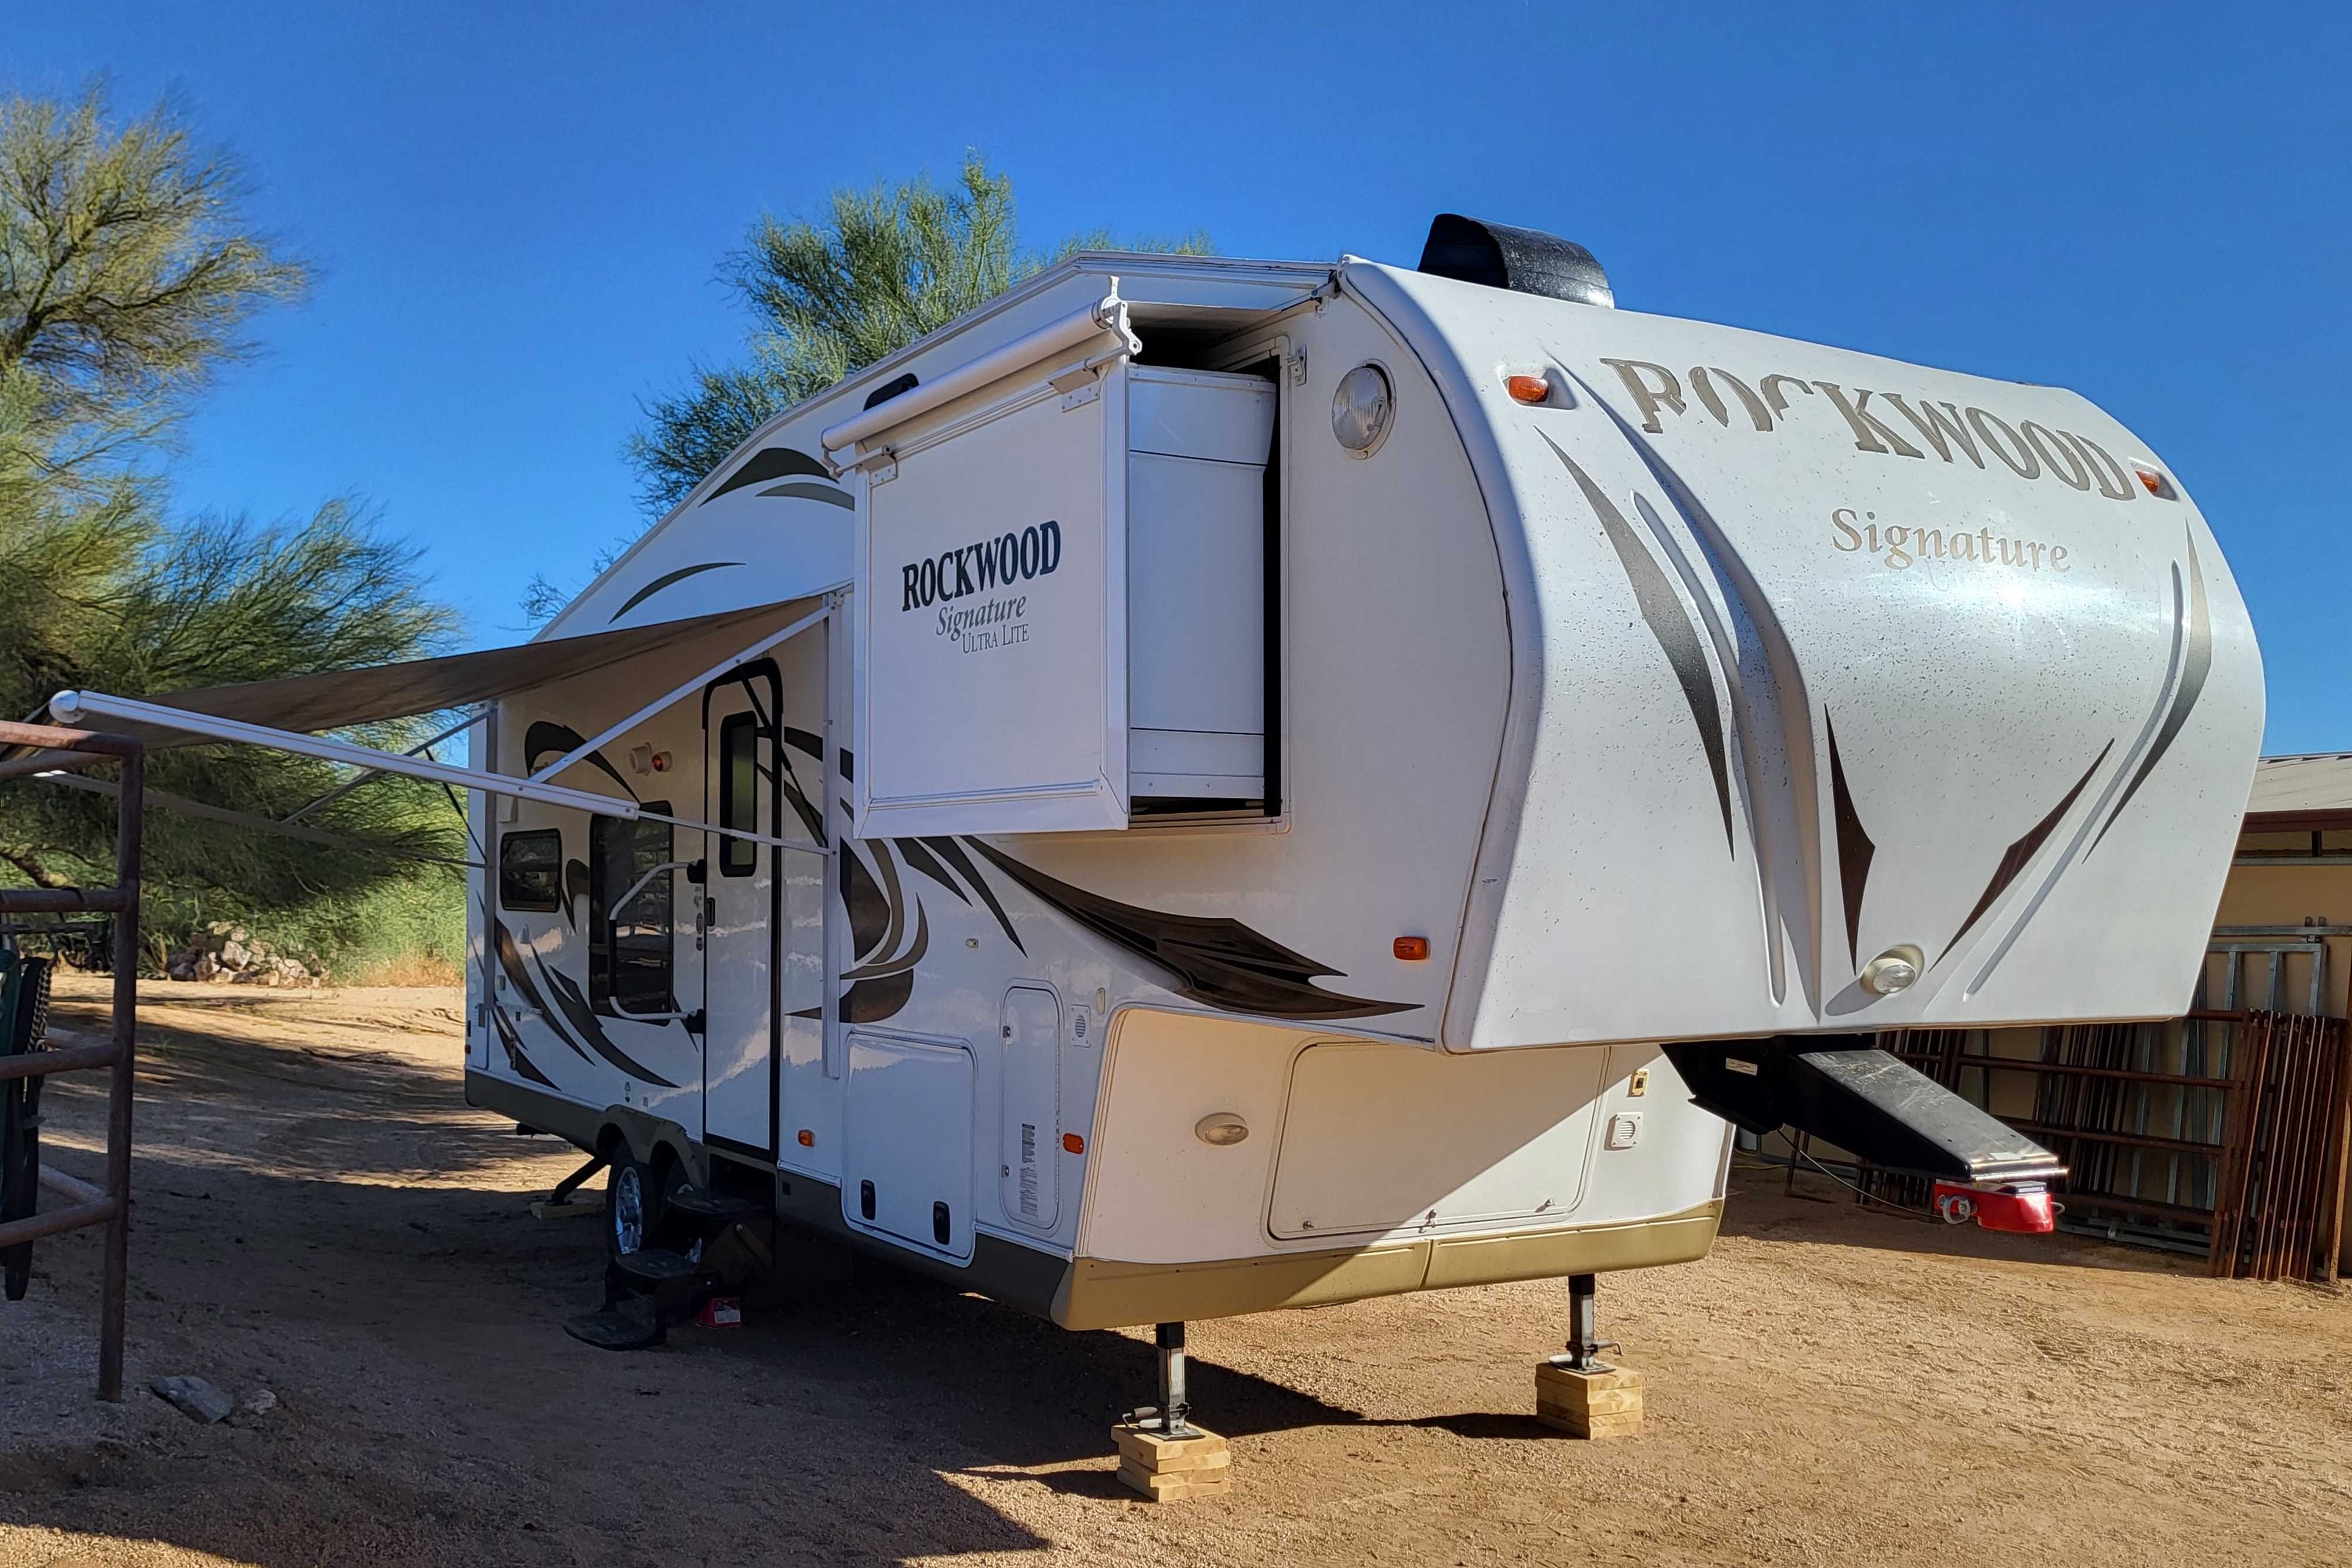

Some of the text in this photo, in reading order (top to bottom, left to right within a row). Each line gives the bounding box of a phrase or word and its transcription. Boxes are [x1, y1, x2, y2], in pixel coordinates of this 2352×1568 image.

[903, 520, 1061, 611] ROCKWOOD
[1832, 509, 2071, 571] Signature
[936, 596, 1027, 641] Signature
[962, 624, 1029, 653] ULTRA LITE
